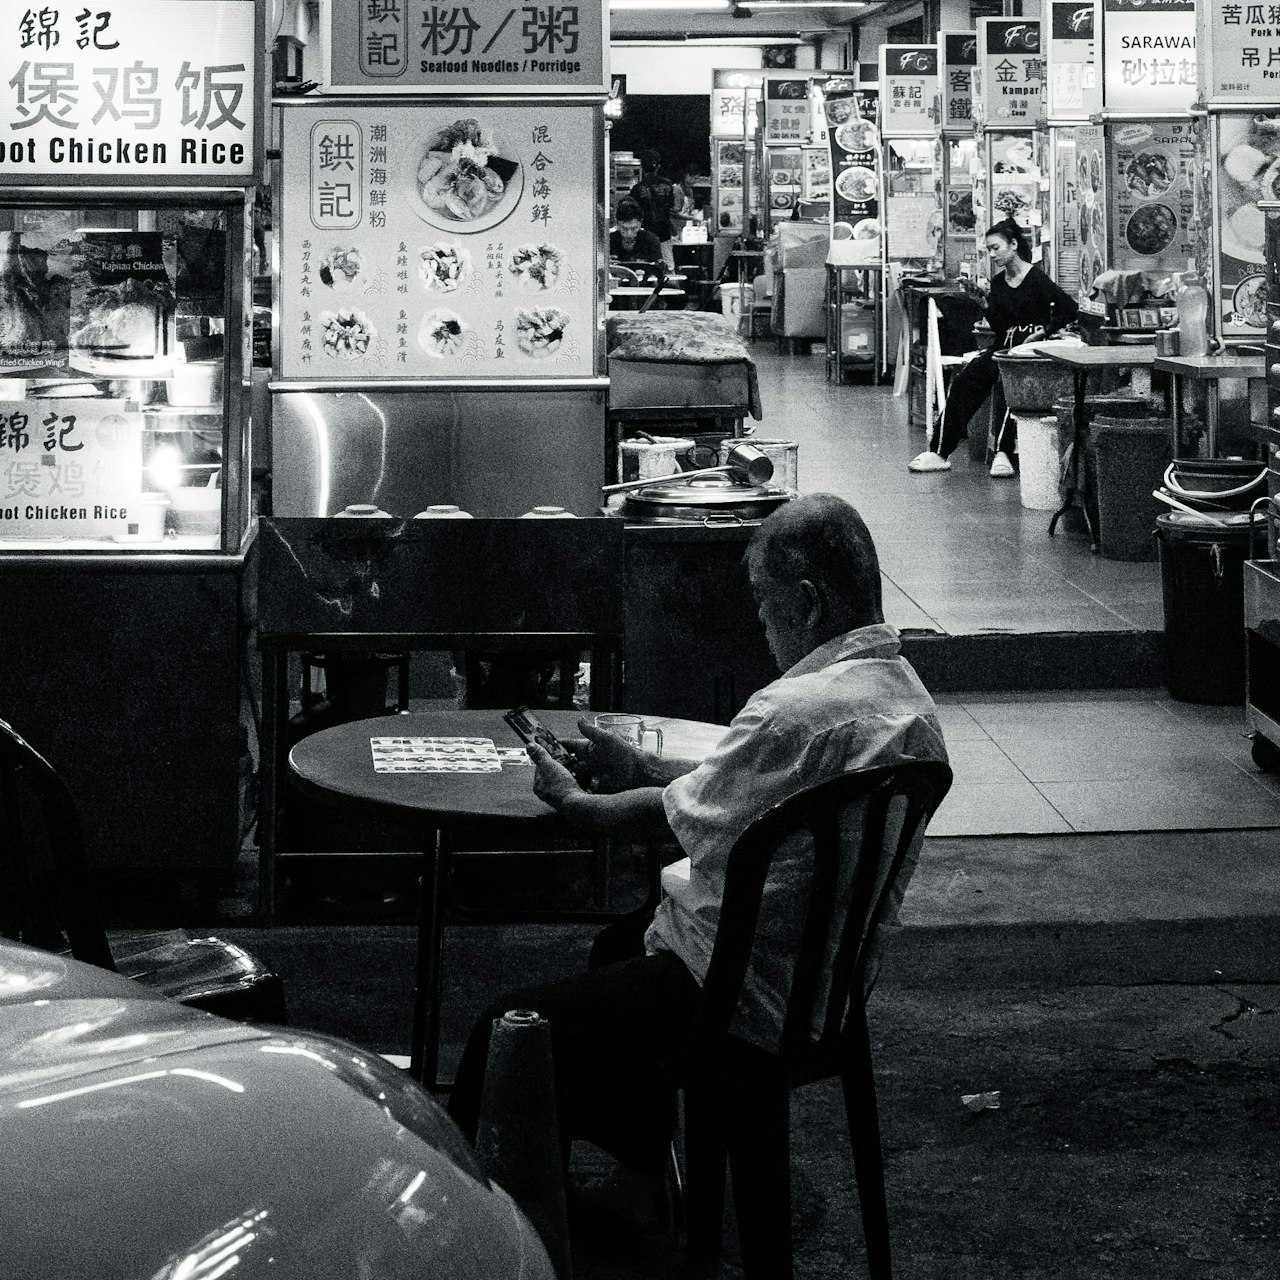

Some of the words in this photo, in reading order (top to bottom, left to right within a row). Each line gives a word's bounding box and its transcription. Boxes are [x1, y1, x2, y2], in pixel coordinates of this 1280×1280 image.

[19, 6, 120, 51] 錦記
[1251, 28, 1272, 37] Pork
[421, 60, 468, 73] Seafood
[472, 60, 519, 73] Noodles
[531, 60, 581, 73] Porridge
[1002, 86, 1039, 96] Kampar
[49, 137, 166, 164] Chicken
[181, 138, 244, 164] Rice
[133, 261, 164, 270] Chicken
[18, 359, 44, 367] Chicken
[25, 506, 87, 519] Chicken
[94, 506, 127, 519] Rice
